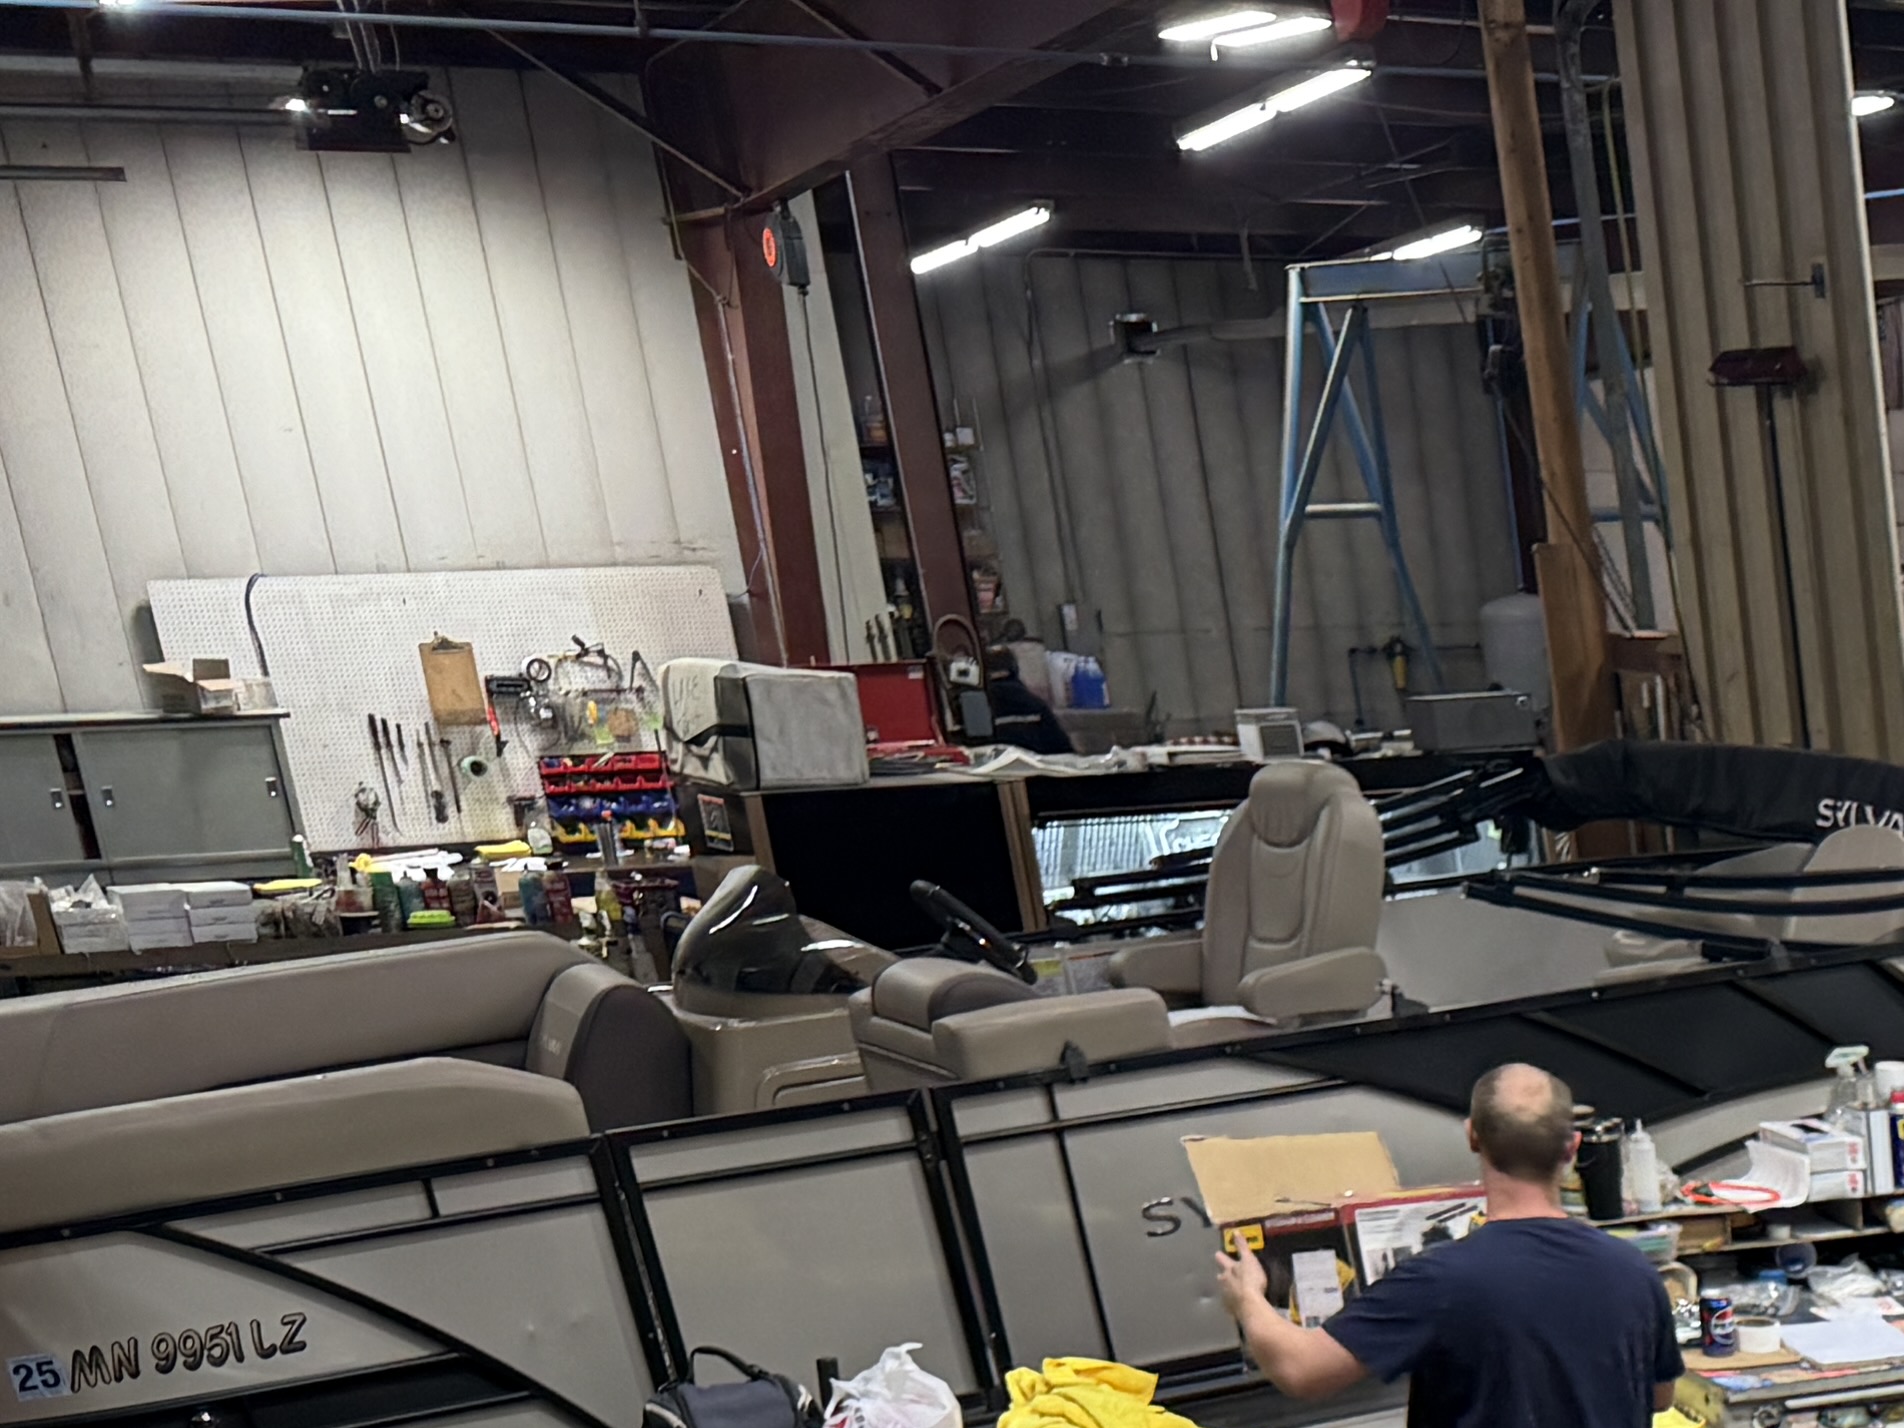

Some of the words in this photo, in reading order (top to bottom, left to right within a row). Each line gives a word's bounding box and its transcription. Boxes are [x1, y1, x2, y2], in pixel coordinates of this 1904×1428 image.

[12, 1359, 62, 1394] 25
[69, 1336, 141, 1394] MN
[150, 1320, 245, 1375] 9951
[249, 1311, 308, 1361] LZ
